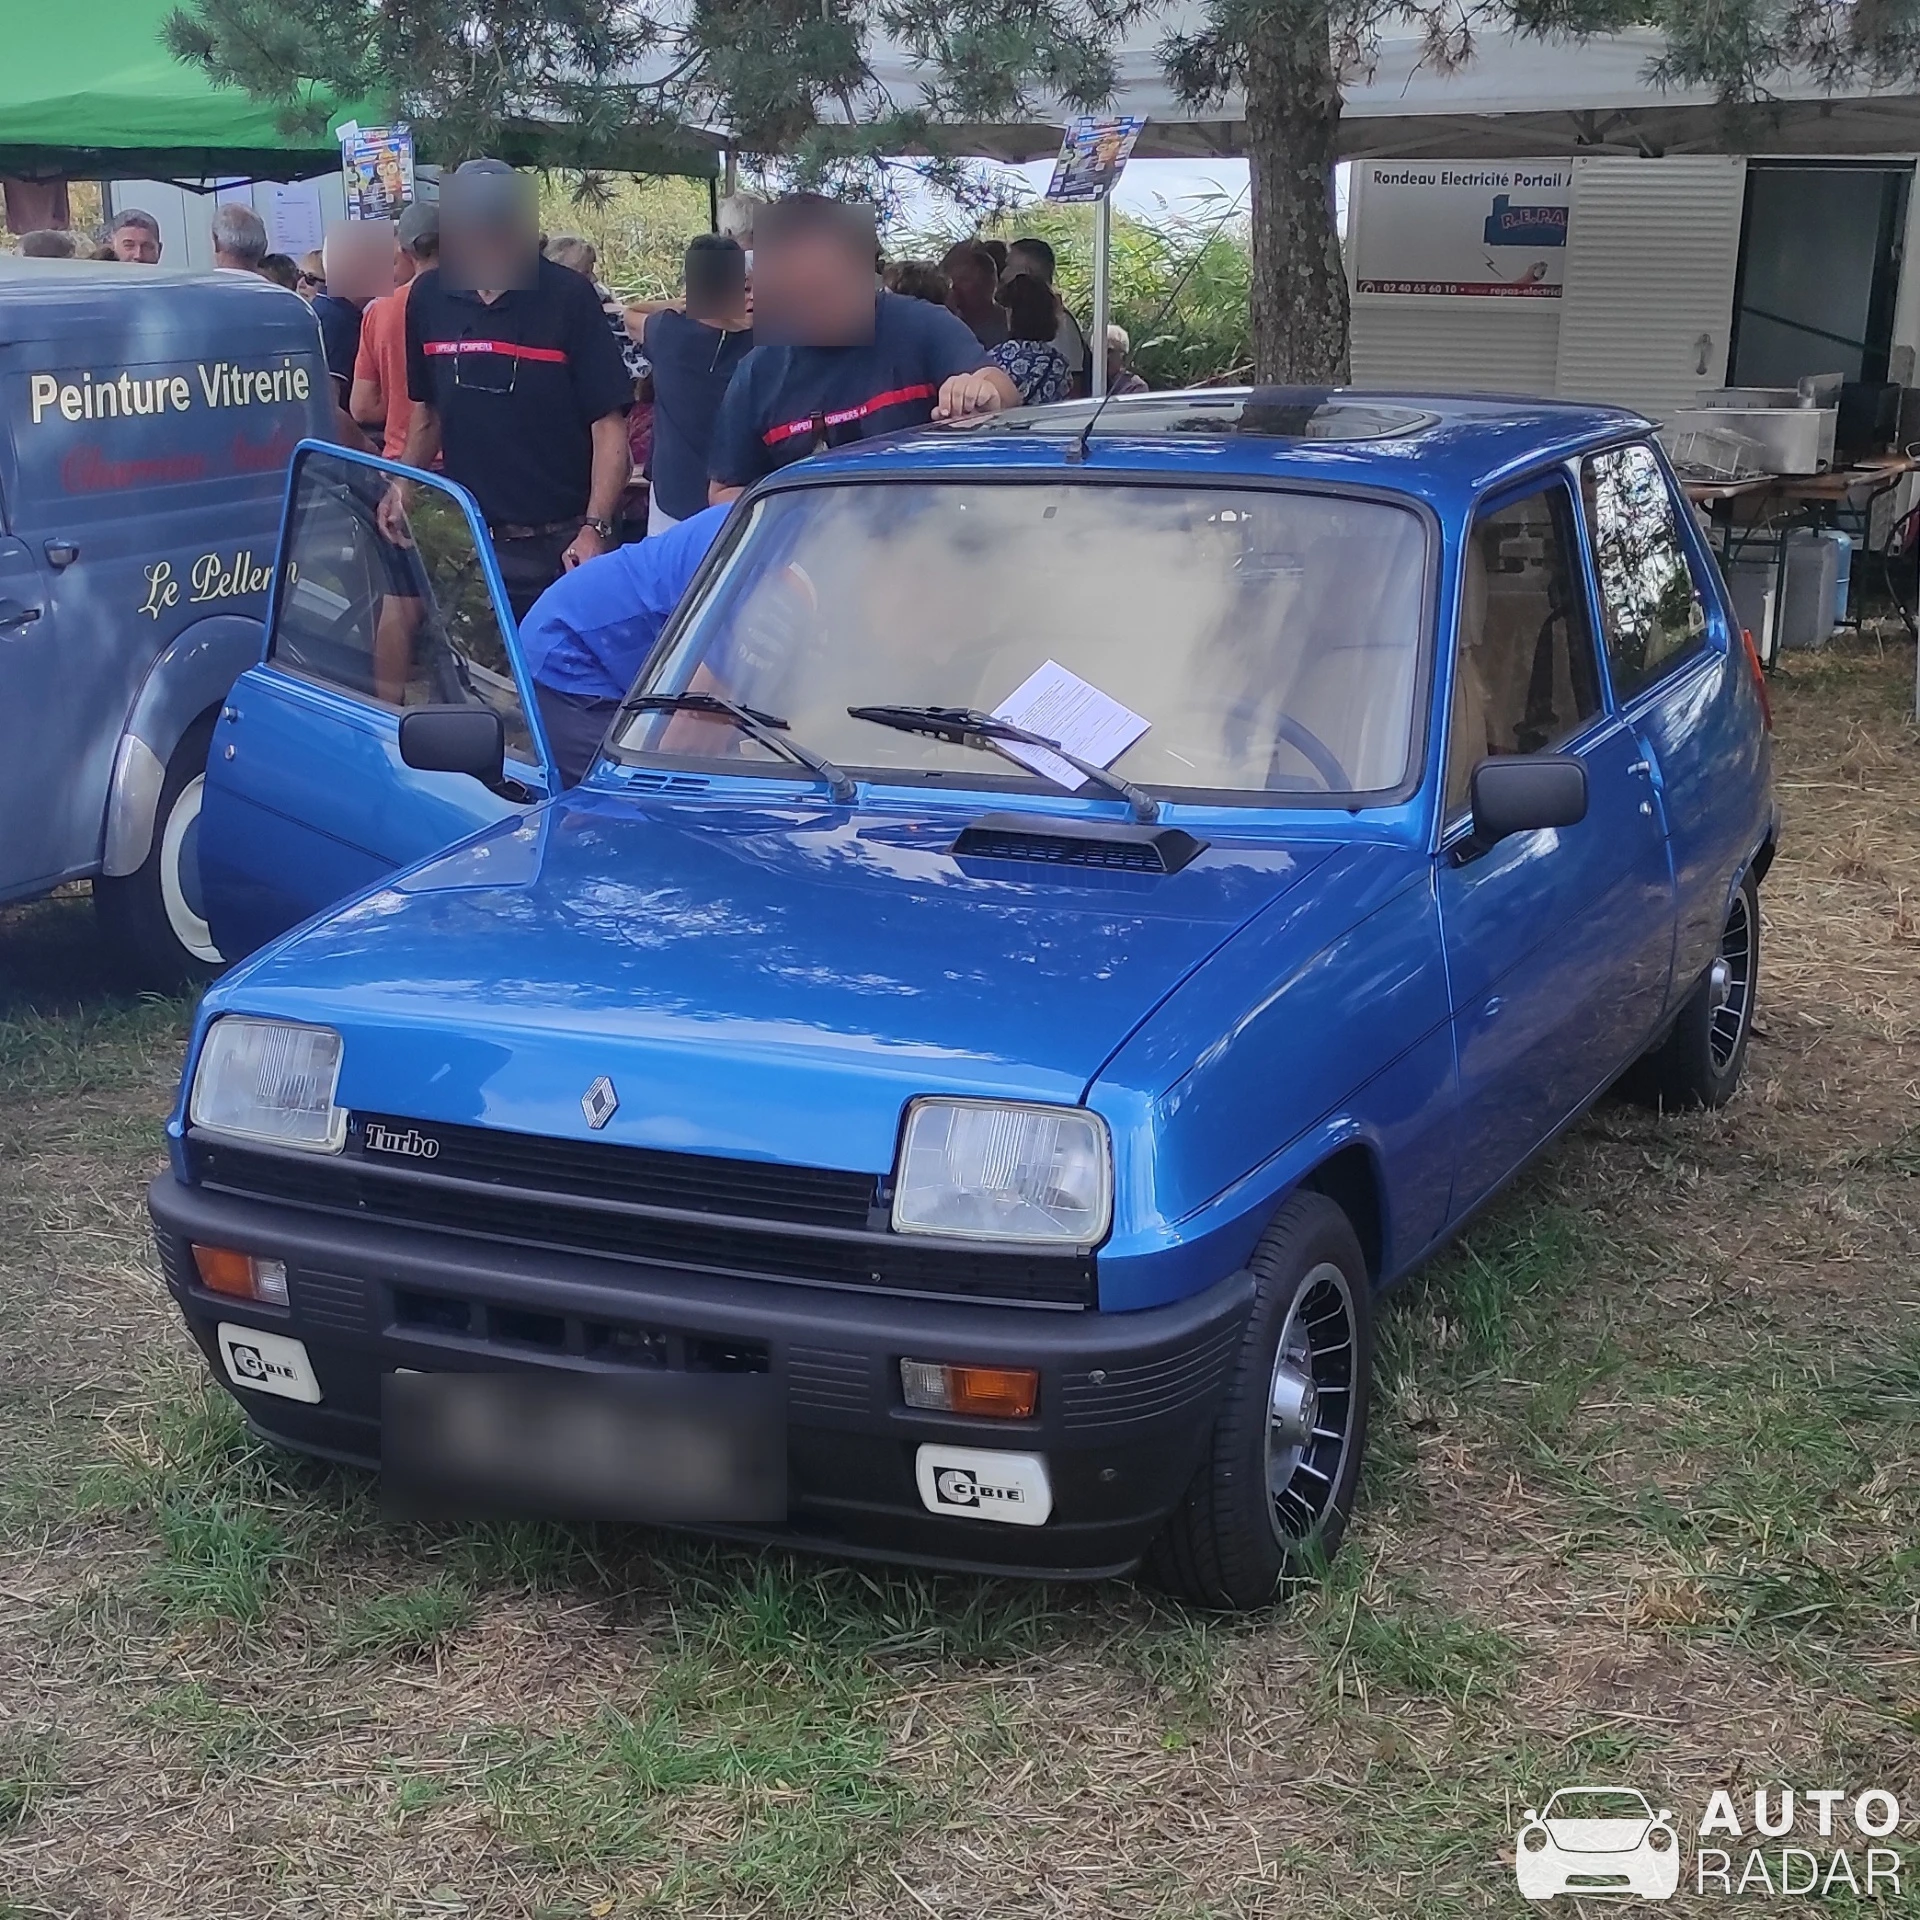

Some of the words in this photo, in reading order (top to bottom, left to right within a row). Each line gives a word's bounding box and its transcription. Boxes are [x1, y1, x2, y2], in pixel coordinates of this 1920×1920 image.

[1374, 171, 1436, 186] Rondeau
[1441, 171, 1509, 187] Electricité
[1514, 172, 1561, 187] Portail
[1383, 283, 1396, 293] 02
[1398, 283, 1411, 293] 40
[1413, 284, 1426, 293] 65
[1428, 284, 1442, 294] 60
[1445, 284, 1457, 294] 10
[31, 372, 191, 424] Peinture
[198, 358, 310, 408] Vitrerie
[137, 561, 181, 620] Le
[189, 551, 299, 602] Pellern
[366, 1123, 439, 1158] Turbo
[246, 1359, 294, 1378] CIBIE
[954, 1484, 1019, 1501] CIBIE
